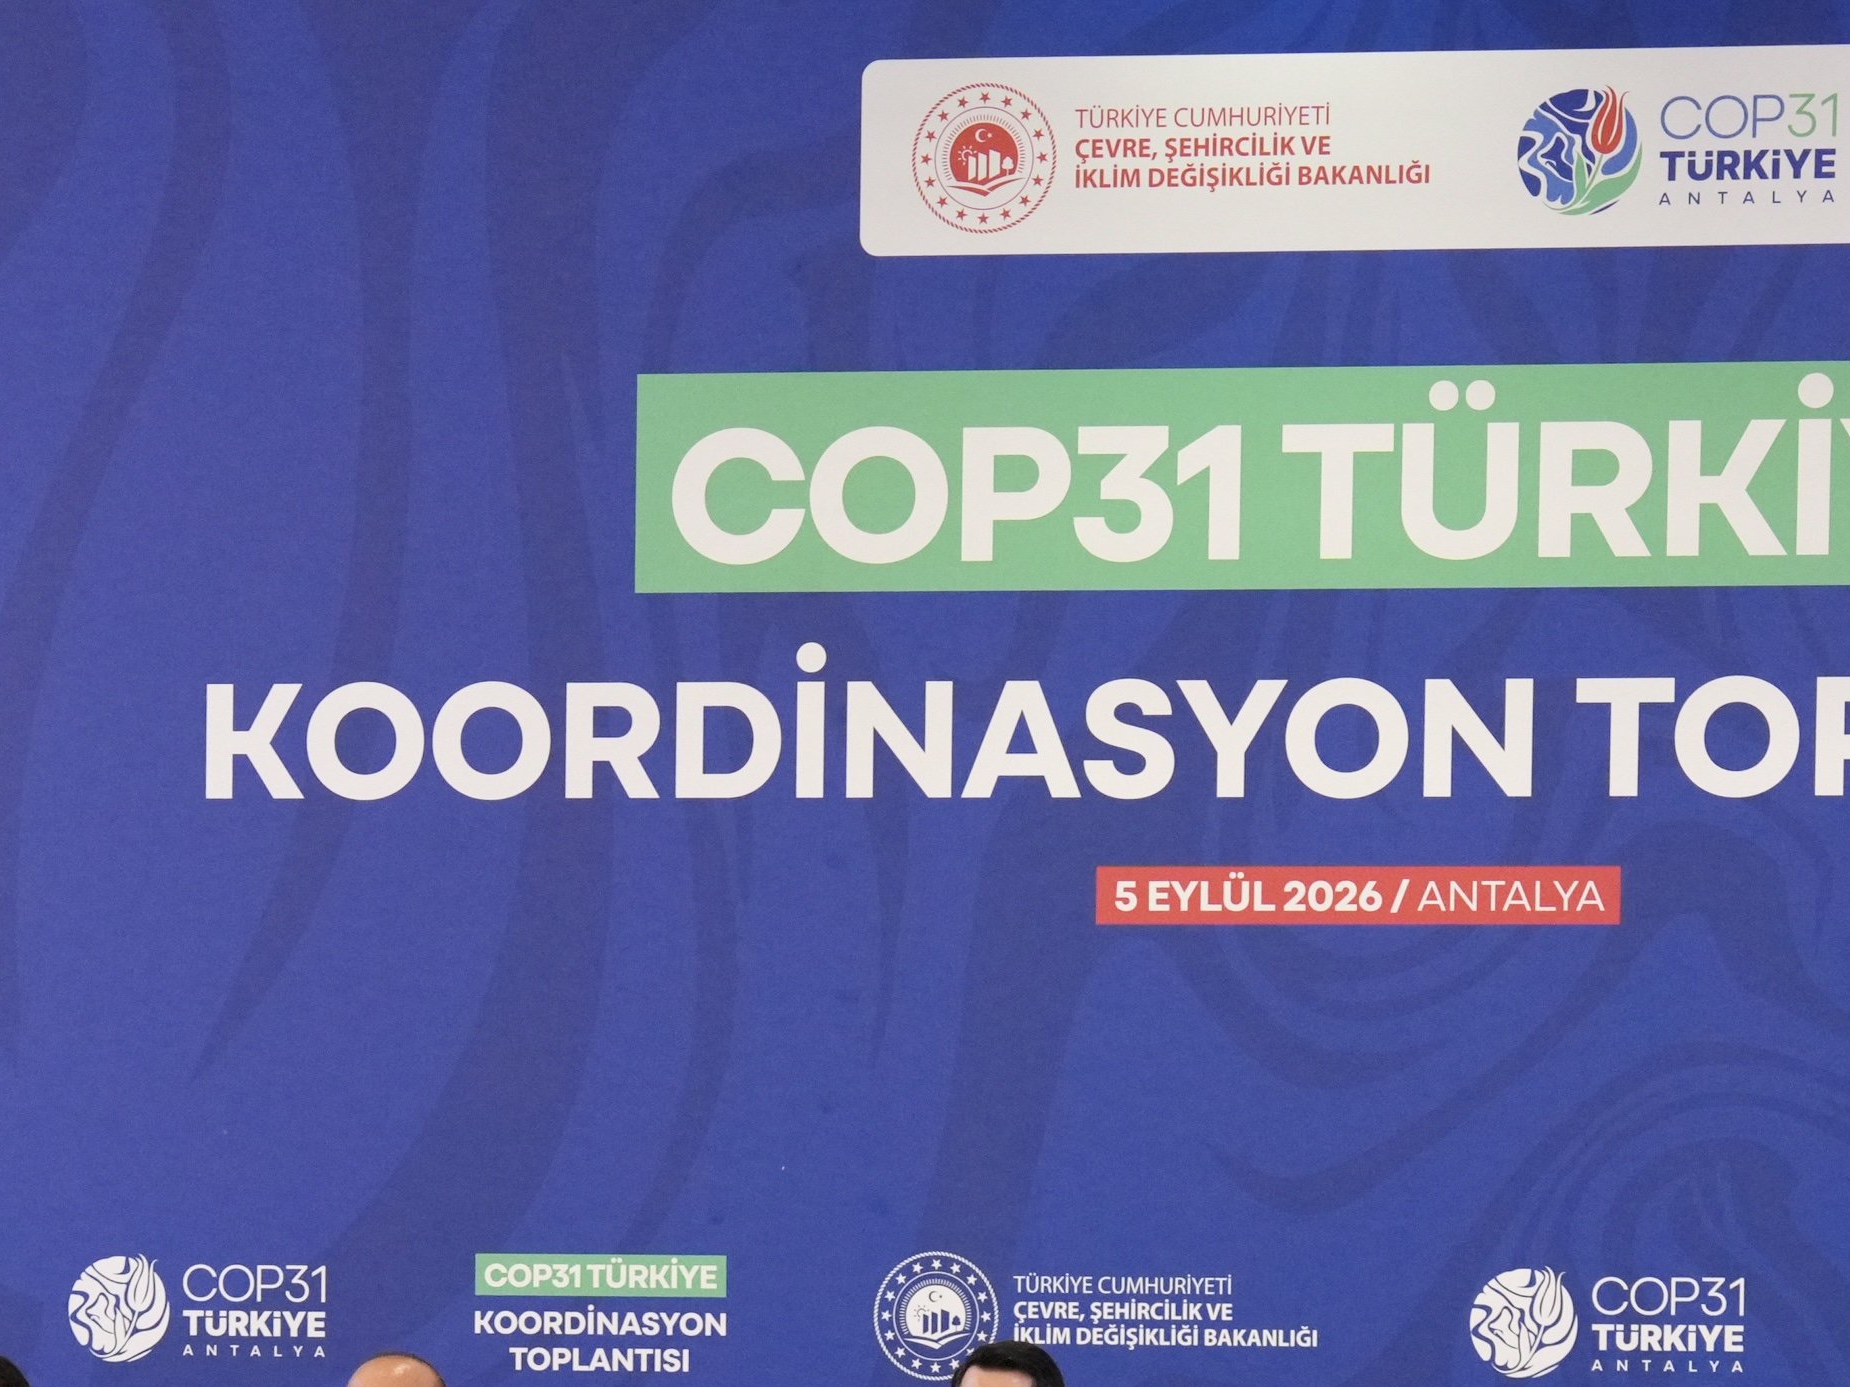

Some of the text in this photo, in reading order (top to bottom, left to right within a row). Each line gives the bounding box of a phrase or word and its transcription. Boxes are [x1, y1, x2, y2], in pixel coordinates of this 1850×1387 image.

[1075, 102, 1329, 128] TÜRKİYE CUMHURİYETİ
[1661, 94, 1837, 139] COP31
[1076, 132, 1330, 163] ÇEVRE, ŞEHİRCİLİK VE
[1076, 160, 1429, 192] İKLİM DEĞİŞİKLİĞİ BAKANLIĞI
[1660, 149, 1836, 181] TÜRKİYE
[1659, 190, 1834, 205] ANTALYA
[672, 425, 1241, 565] COP31
[206, 642, 1533, 800] KOORDİNASYON
[1115, 872, 1605, 913] 5 EYLÜL 2026 / ANTALYA
[183, 1264, 326, 1302] COP31
[485, 1257, 717, 1289] COP31 TÜRKİYE
[1013, 1272, 1231, 1294] TÜRKİYE CUMHURİYETİ
[1014, 1299, 1232, 1324] ÇEVRE, ŞEHİRCİLİK VE
[1592, 1277, 1744, 1316] COP31
[183, 1310, 325, 1337] TÜRKİYE
[475, 1305, 726, 1336] KOORDİNASYON
[183, 1345, 325, 1357] ANTALYA
[1014, 1324, 1317, 1350] İKLİM DEĞİŞİKLİĞİ BAKANLIĞI
[1592, 1324, 1744, 1352] TÜRKİYE
[509, 1347, 689, 1372] TOPLANTISI
[1592, 1360, 1742, 1372] ANTALYA
